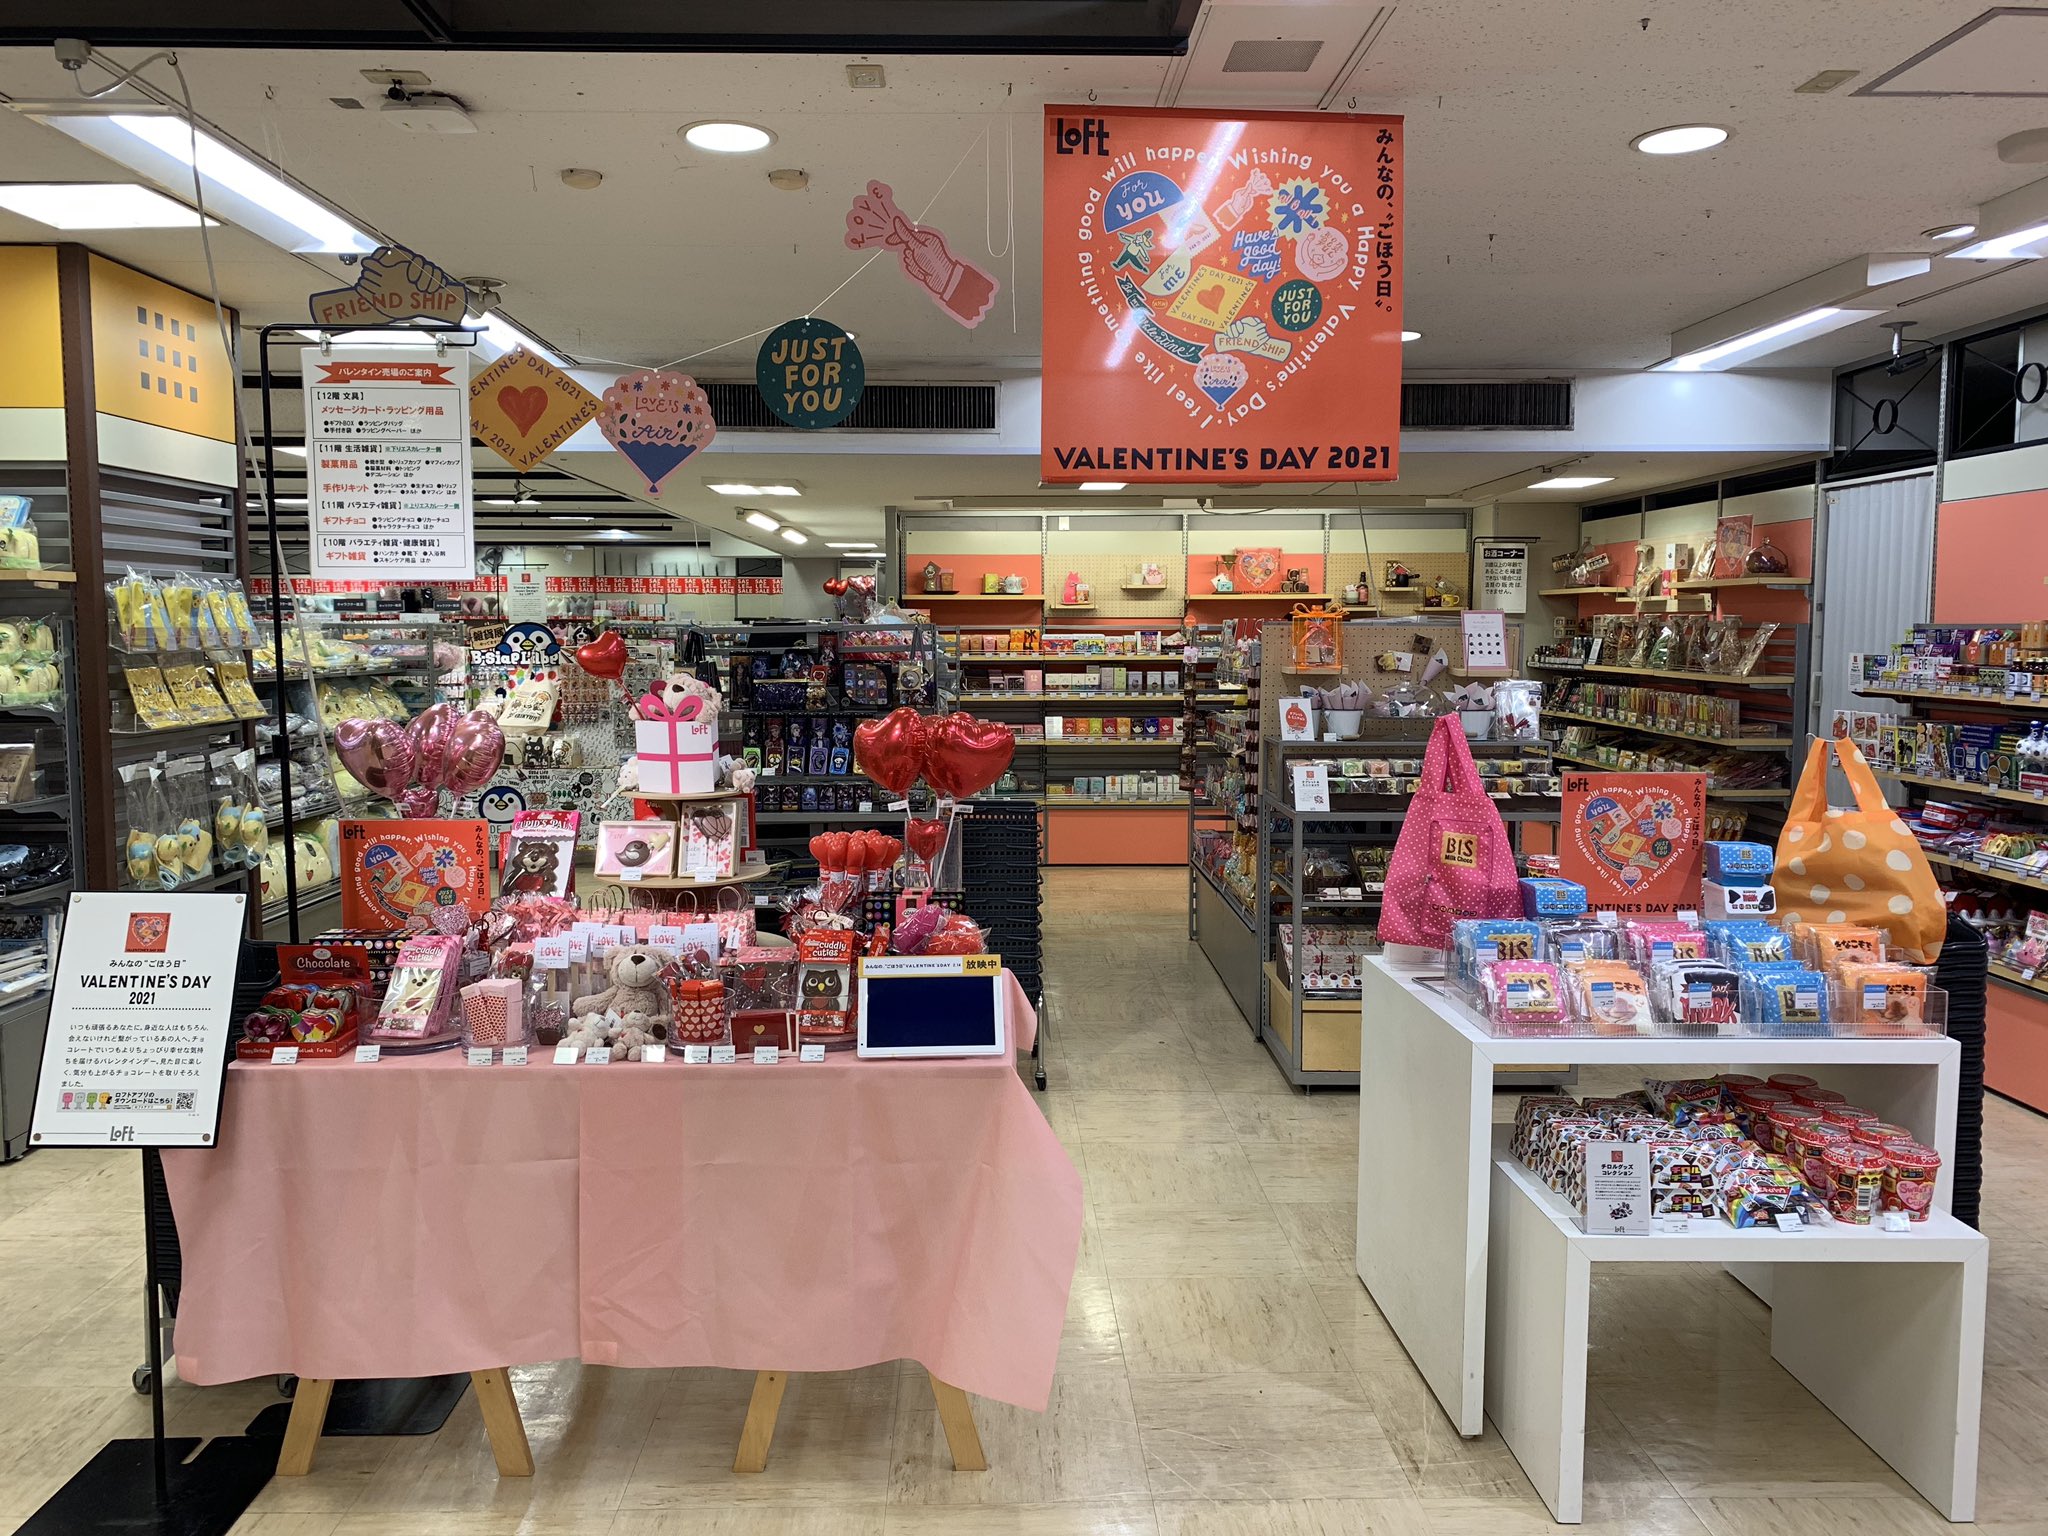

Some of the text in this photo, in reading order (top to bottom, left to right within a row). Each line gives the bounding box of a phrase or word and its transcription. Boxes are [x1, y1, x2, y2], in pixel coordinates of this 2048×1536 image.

[1227, 147, 1313, 170] Wishing
[1101, 152, 1137, 183] will
[1319, 165, 1353, 195] you
[1078, 187, 1102, 241] good
[1351, 203, 1365, 217] a
[1348, 226, 1376, 292] Happy
[1279, 288, 1314, 302] JUST
[1284, 300, 1312, 313] FOR
[1283, 311, 1312, 325] YOU
[771, 336, 847, 364] JUST
[1135, 351, 1165, 385] like
[527, 356, 582, 400] DAY 2021
[785, 362, 842, 390] FOR
[783, 387, 843, 414] YOU
[489, 400, 598, 466] 2021 VALENTINE'S
[1054, 446, 1390, 471] VALENTINE'S DAY 2021
[1446, 837, 1474, 857] BIS
[1646, 903, 1669, 913] DAY
[597, 936, 615, 946] LOVE
[654, 935, 676, 944] LOVE
[819, 941, 847, 951] cuddly
[416, 946, 443, 956] cuddly
[540, 948, 562, 957] LOVE
[682, 942, 705, 952] LOVE
[812, 949, 839, 957] cuties
[296, 957, 350, 969] Chocolate
[407, 954, 434, 962] cuties
[966, 960, 998, 969] 放映中
[80, 974, 212, 989] VALENTINE'S DAY
[129, 992, 156, 1005] 2021
